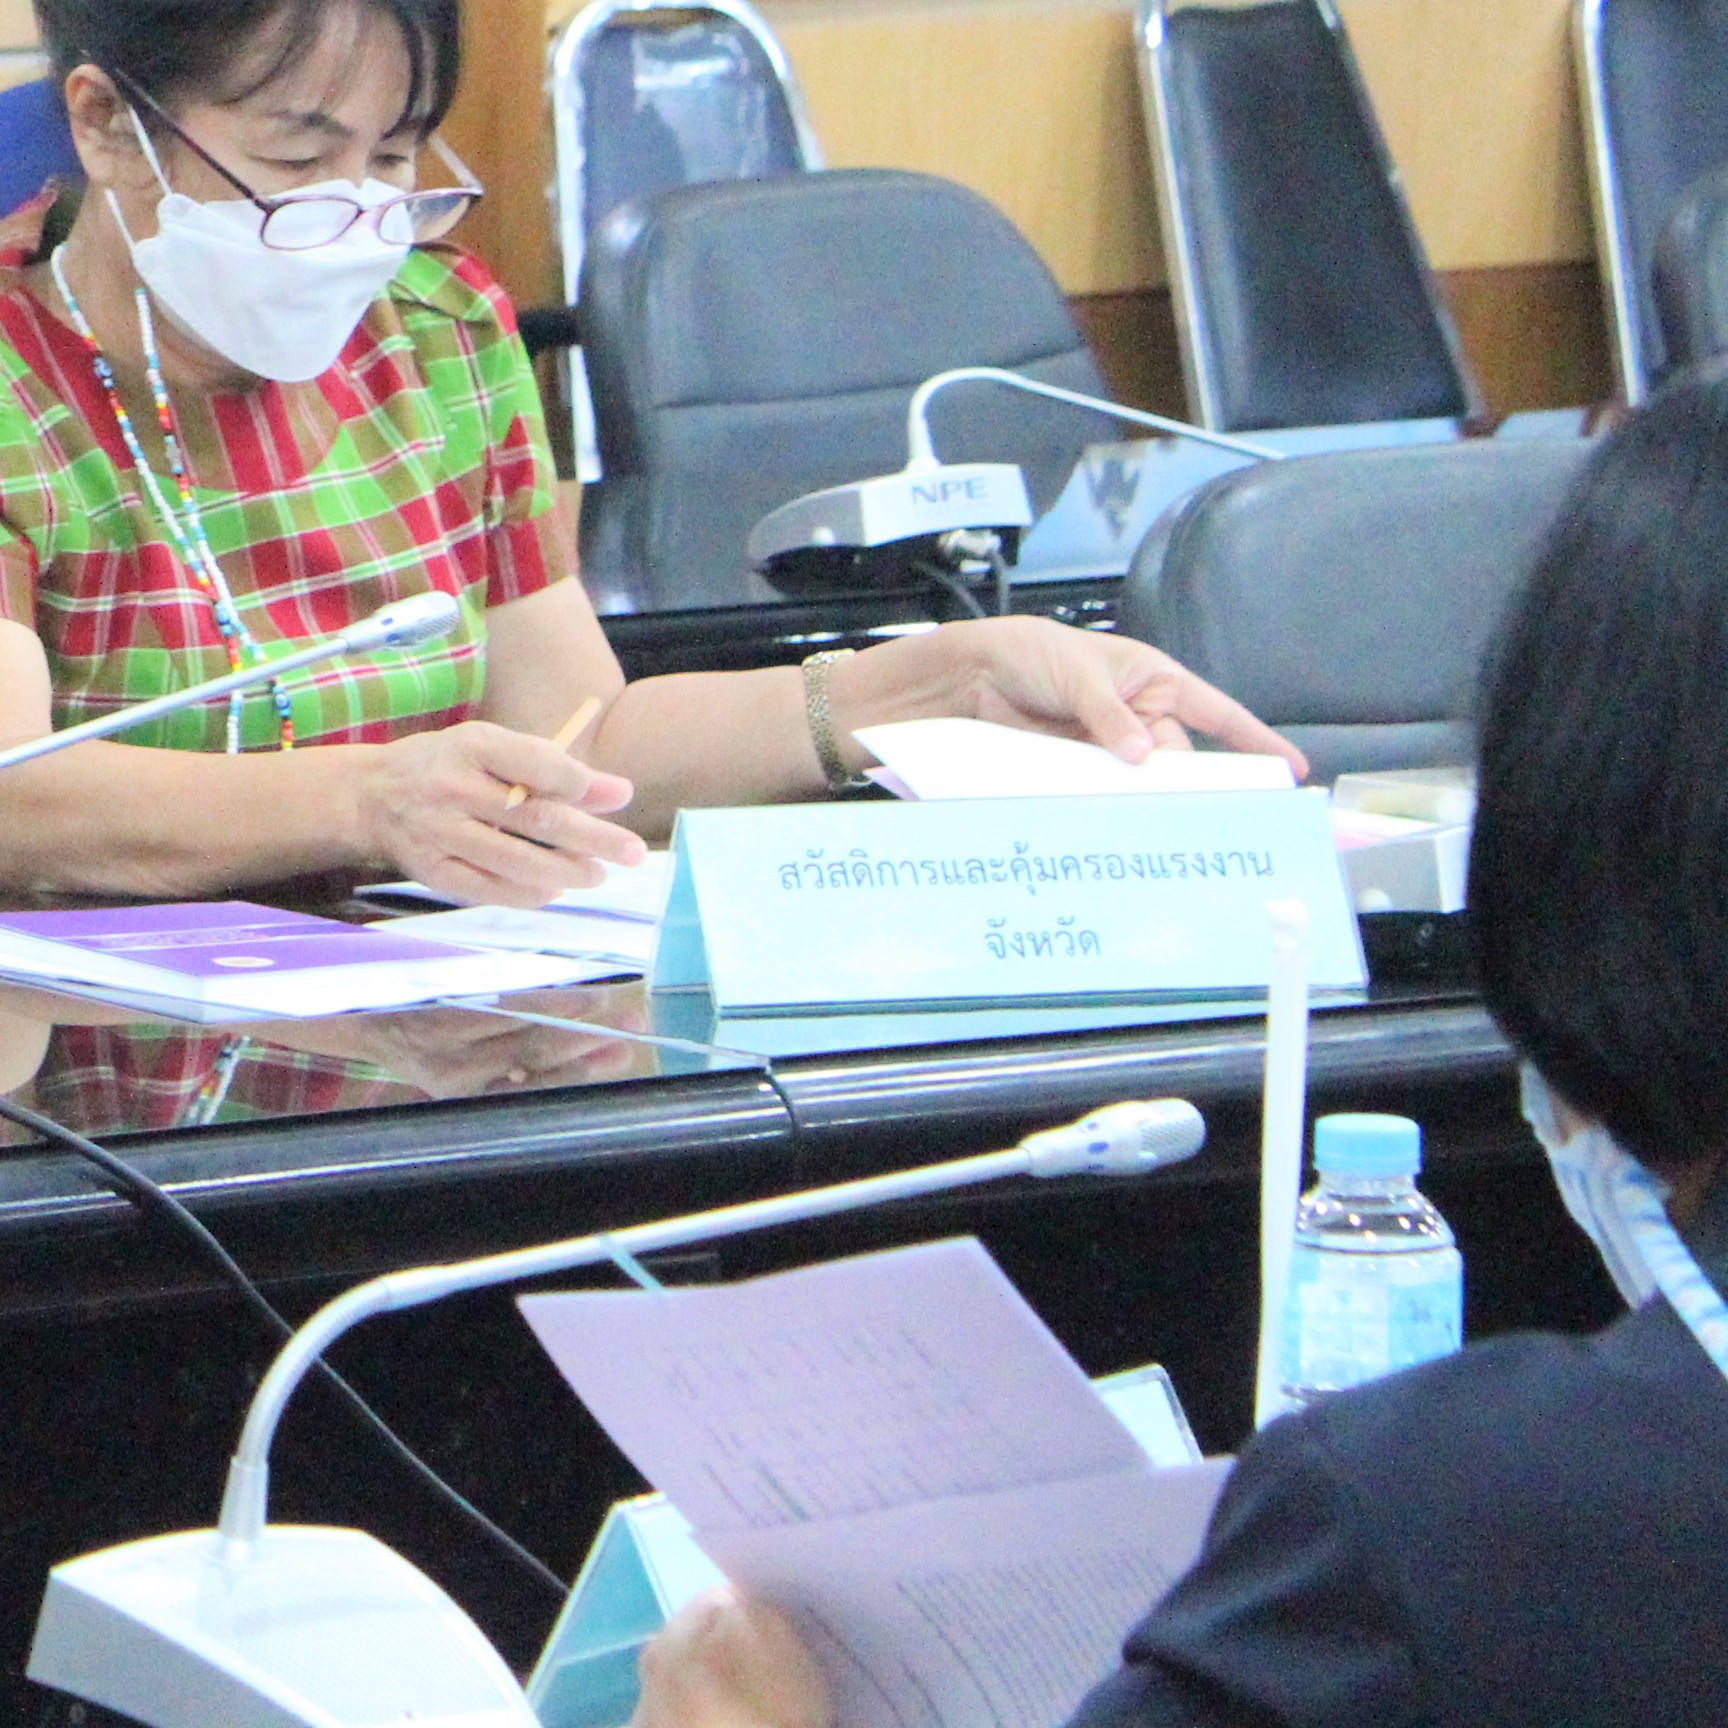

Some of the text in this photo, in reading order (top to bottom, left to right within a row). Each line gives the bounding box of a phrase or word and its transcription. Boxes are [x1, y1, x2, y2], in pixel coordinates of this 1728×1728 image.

[911, 476, 989, 505] NPE
[777, 840, 1275, 896] สวัสดิการและคุ้มครองแรงงาน
[983, 915, 1102, 961] จังหวัด
